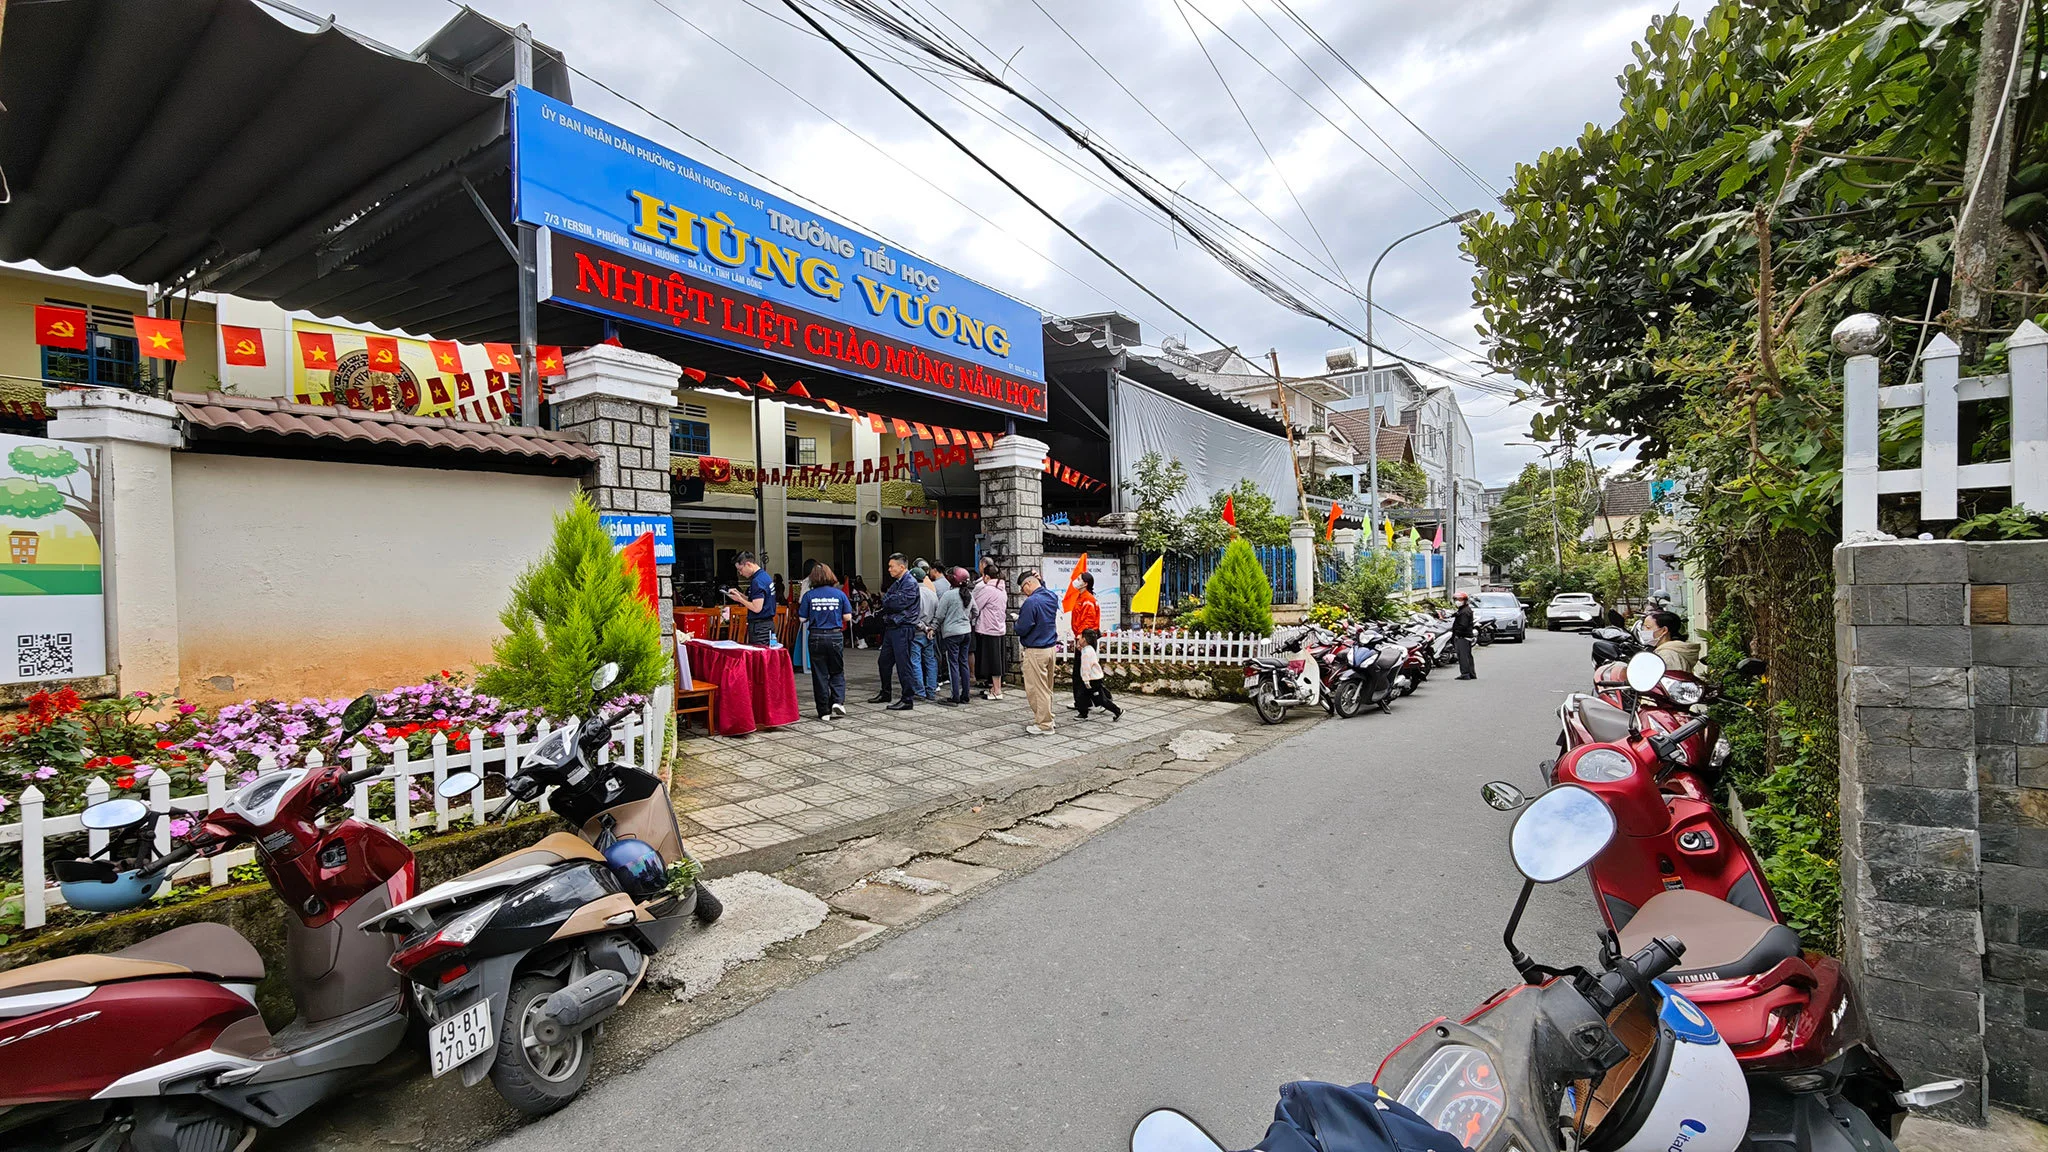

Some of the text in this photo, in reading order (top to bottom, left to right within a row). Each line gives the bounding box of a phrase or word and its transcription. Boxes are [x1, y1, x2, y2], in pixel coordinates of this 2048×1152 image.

[541, 104, 557, 122] ỦY
[559, 113, 582, 133] BAN
[583, 124, 613, 146] NHÂN
[614, 137, 635, 156] DÂN
[637, 146, 676, 172] PHƯỜNG
[677, 164, 701, 184] XUÂN
[702, 175, 732, 197] HƯƠNG
[738, 192, 750, 205] ĐÀ
[751, 196, 765, 211] LẠT
[543, 211, 560, 226] 7/3
[561, 217, 595, 238] YERSIN,
[596, 228, 630, 249] PHƯỜNG
[632, 240, 653, 257] XUÂN
[654, 247, 680, 264] HƯƠNG
[766, 209, 940, 293] TRƯỜNG TIỂU HỌC
[629, 189, 1011, 358] HÙNG VƯƠNG
[574, 252, 715, 327] NHIỆT
[720, 297, 799, 349] LIỆT
[804, 323, 881, 369] CHÀO
[884, 346, 955, 389] MỪNG
[958, 364, 1004, 401] NĂM
[1005, 380, 1041, 414] HỌC
[609, 520, 632, 537] CẤM
[654, 523, 667, 537] XE
[1677, 971, 1720, 984] YAMAHA
[436, 1026, 486, 1072] 370.97
